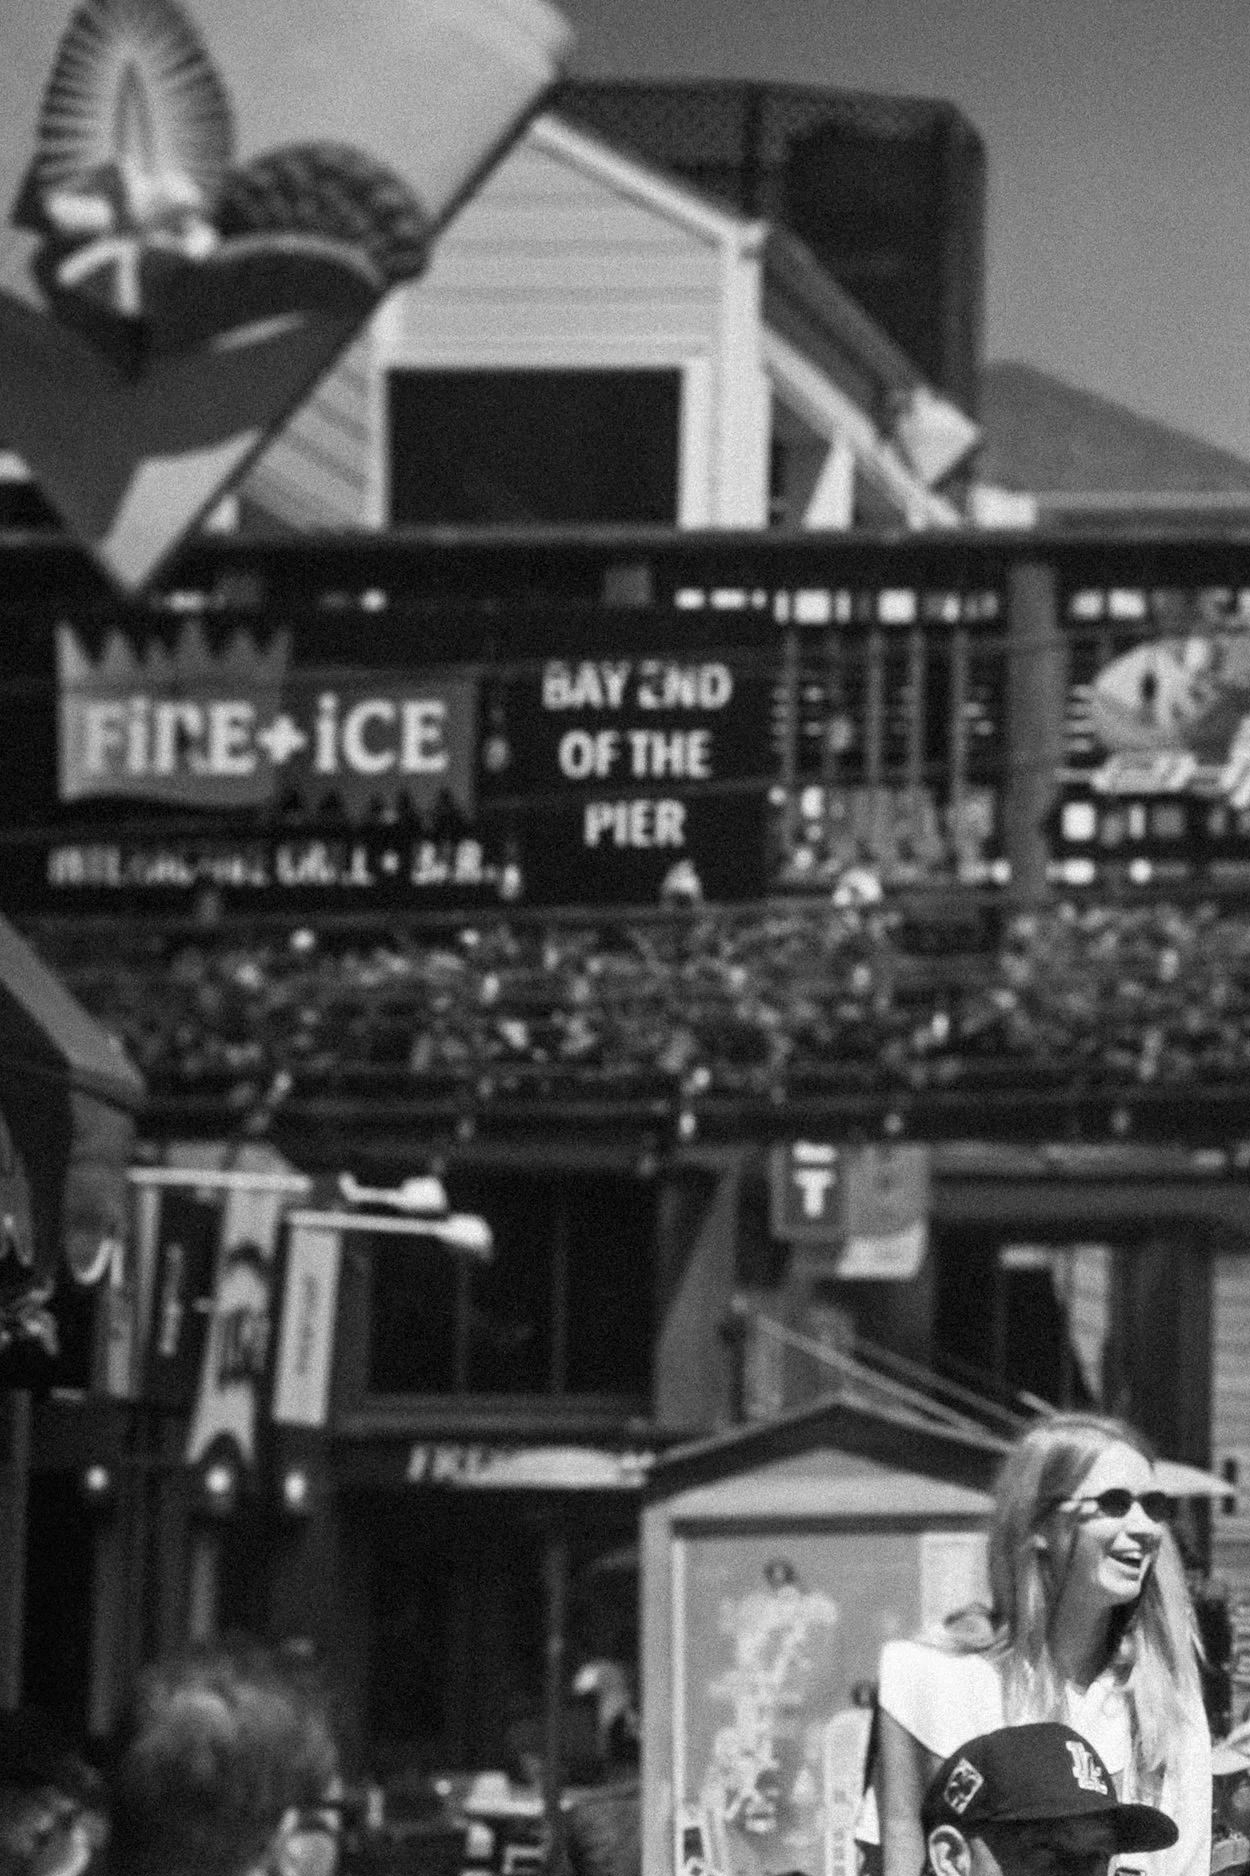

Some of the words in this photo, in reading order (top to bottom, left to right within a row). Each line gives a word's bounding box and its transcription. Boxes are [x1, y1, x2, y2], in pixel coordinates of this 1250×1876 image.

[542, 659, 630, 710] BAY
[559, 729, 620, 780] OF
[627, 729, 711, 780] THE
[584, 799, 686, 848] PIER
